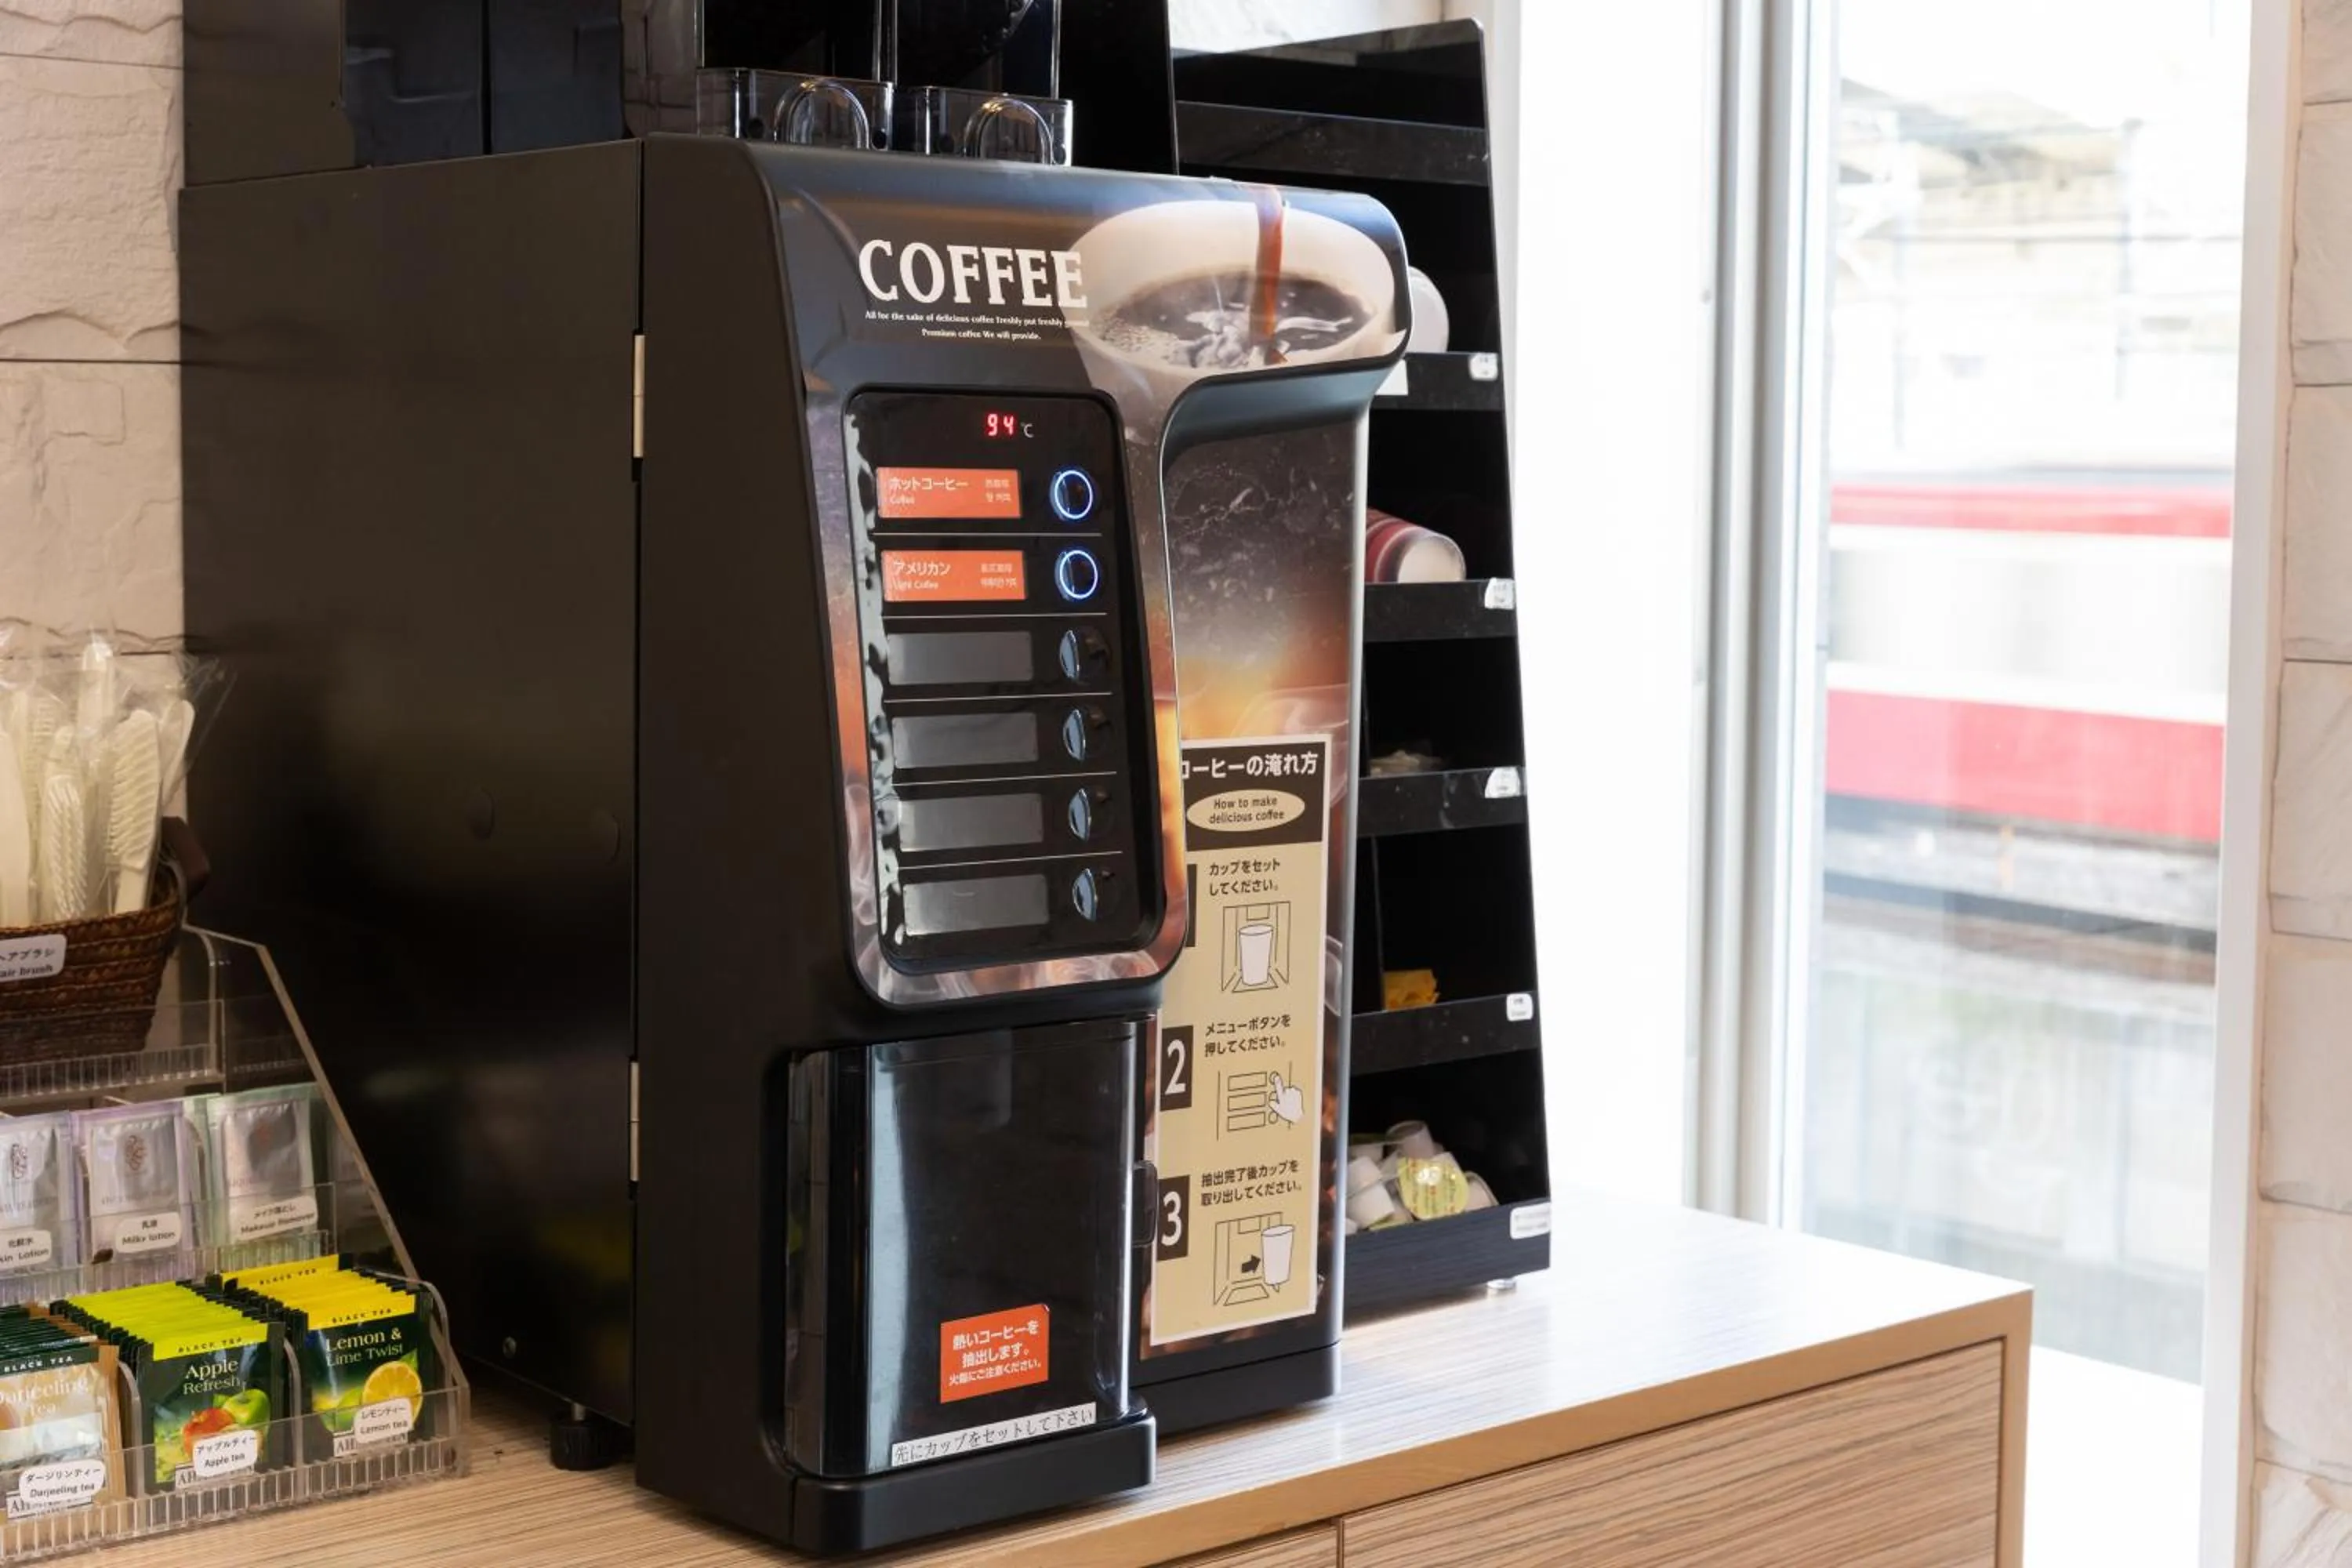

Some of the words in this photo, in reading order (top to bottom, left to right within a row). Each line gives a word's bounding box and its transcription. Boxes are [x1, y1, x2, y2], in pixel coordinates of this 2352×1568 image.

[859, 239, 1087, 308] COFFEE
[866, 310, 877, 319] All
[878, 310, 888, 320] for
[891, 311, 905, 321] the
[926, 313, 934, 321] of
[936, 314, 970, 323] delicious
[972, 314, 994, 324] coffee
[958, 329, 982, 339] coffee
[982, 330, 994, 339] We
[1011, 332, 1042, 343] provide.
[986, 412, 1015, 437] 94
[889, 477, 969, 491] ホットコーヒー
[894, 560, 951, 576] アメリカン
[1214, 797, 1236, 809] How
[1238, 798, 1249, 808] to
[1252, 795, 1277, 807] make
[1209, 812, 1253, 824] delicious
[1255, 809, 1285, 821] coffee
[1210, 858, 1280, 877] カップをセット
[1210, 879, 1279, 896] してください。
[1205, 1014, 1291, 1036] メニューボタンを
[1204, 1036, 1286, 1058] 押してください。
[1165, 1039, 1186, 1094] 2
[1201, 1160, 1298, 1188] 抽出完了後カップを
[1201, 1180, 1301, 1206] 取り出してください。
[1161, 1191, 1182, 1246] 3
[332, 1312, 365, 1323] BLACK
[326, 1331, 385, 1352] Lemon
[391, 1327, 402, 1341] &
[953, 1320, 1039, 1350] 熱いコーヒーを
[178, 1341, 214, 1353] BLACK
[327, 1351, 362, 1367] Lime
[365, 1343, 403, 1359] Twist
[962, 1341, 1029, 1368] 抽出します。
[4, 1360, 42, 1372] BLACK
[50, 1356, 73, 1364] TEA
[185, 1359, 238, 1381] Apple
[183, 1375, 240, 1395] Refresh
[360, 1423, 390, 1434] Lemon
[895, 1409, 1092, 1463] 先にカップをセットして下さい
[204, 1456, 229, 1468] Apple
[27, 1468, 100, 1482] ダージリンティー
[31, 1486, 78, 1498] Darjeeling
[81, 1483, 94, 1491] tea
